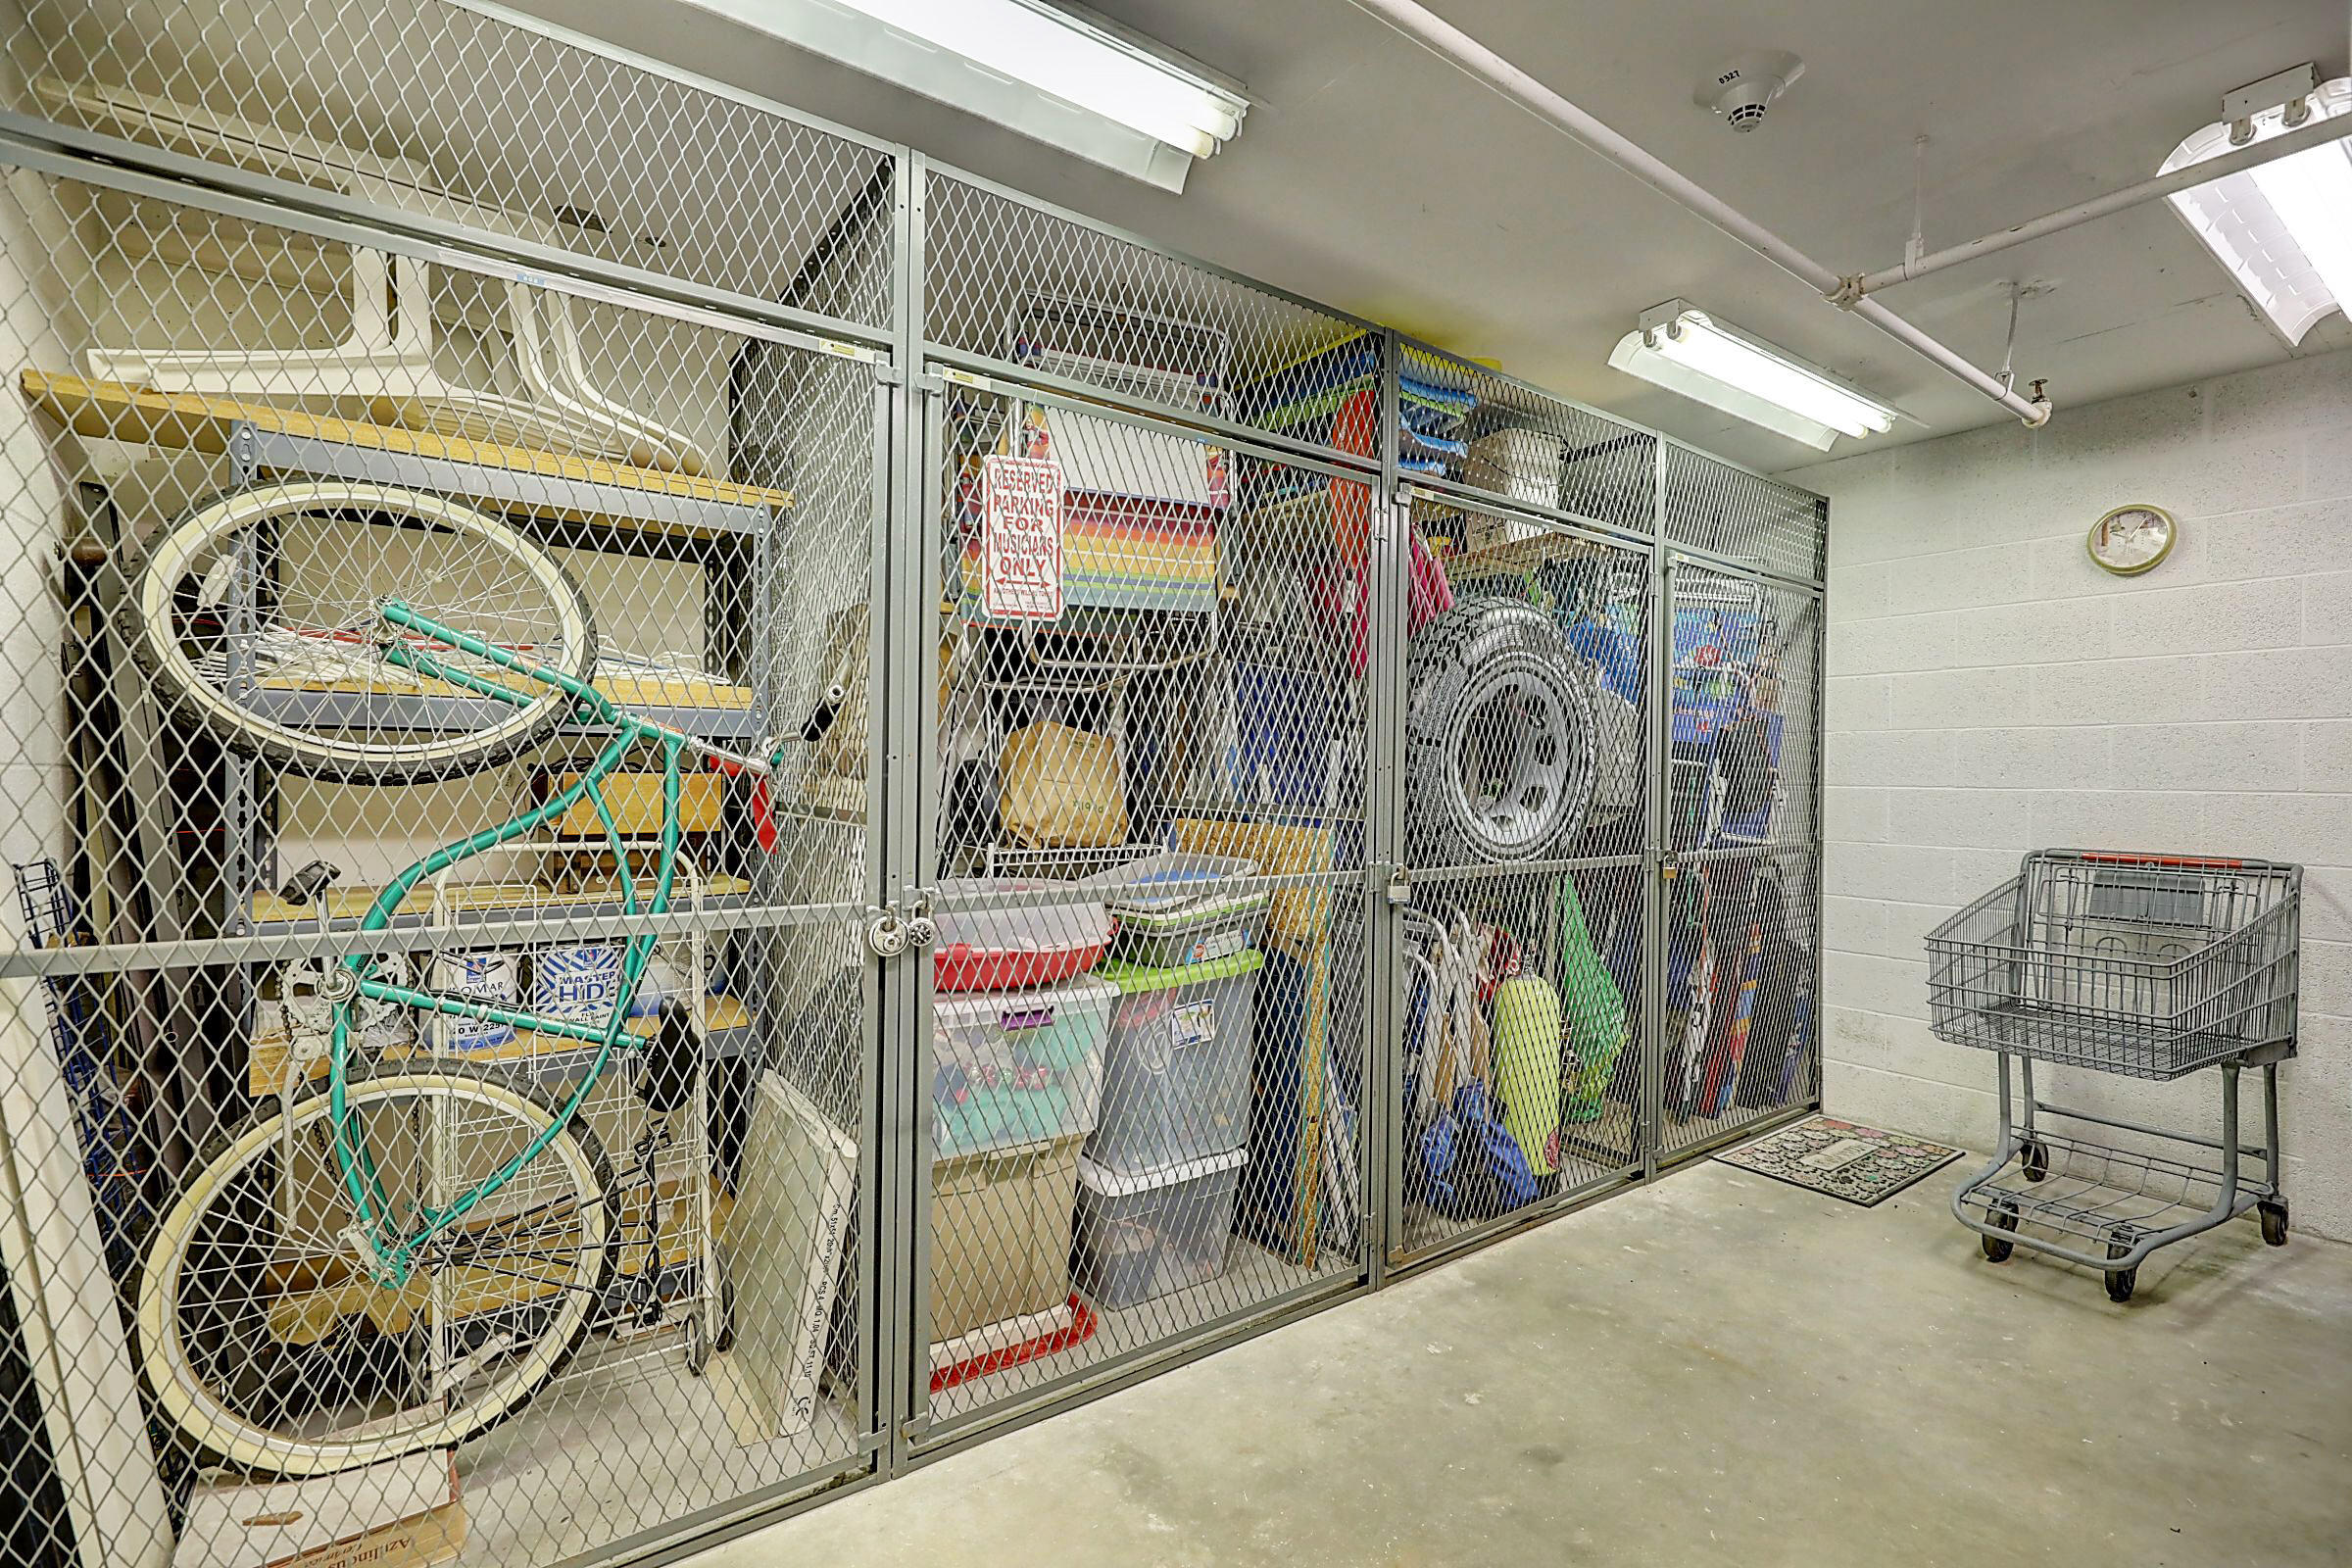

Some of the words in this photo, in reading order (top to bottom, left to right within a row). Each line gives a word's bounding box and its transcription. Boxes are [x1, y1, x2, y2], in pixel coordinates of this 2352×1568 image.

[1718, 70, 1740, 84] 0327
[994, 468, 1054, 494] RESERVED
[994, 494, 1054, 517] PARKING
[1003, 516, 1044, 533] FOR
[994, 532, 1054, 557] MUSICIANS
[1000, 557, 1046, 576] ONLY
[559, 971, 615, 985] MASTER
